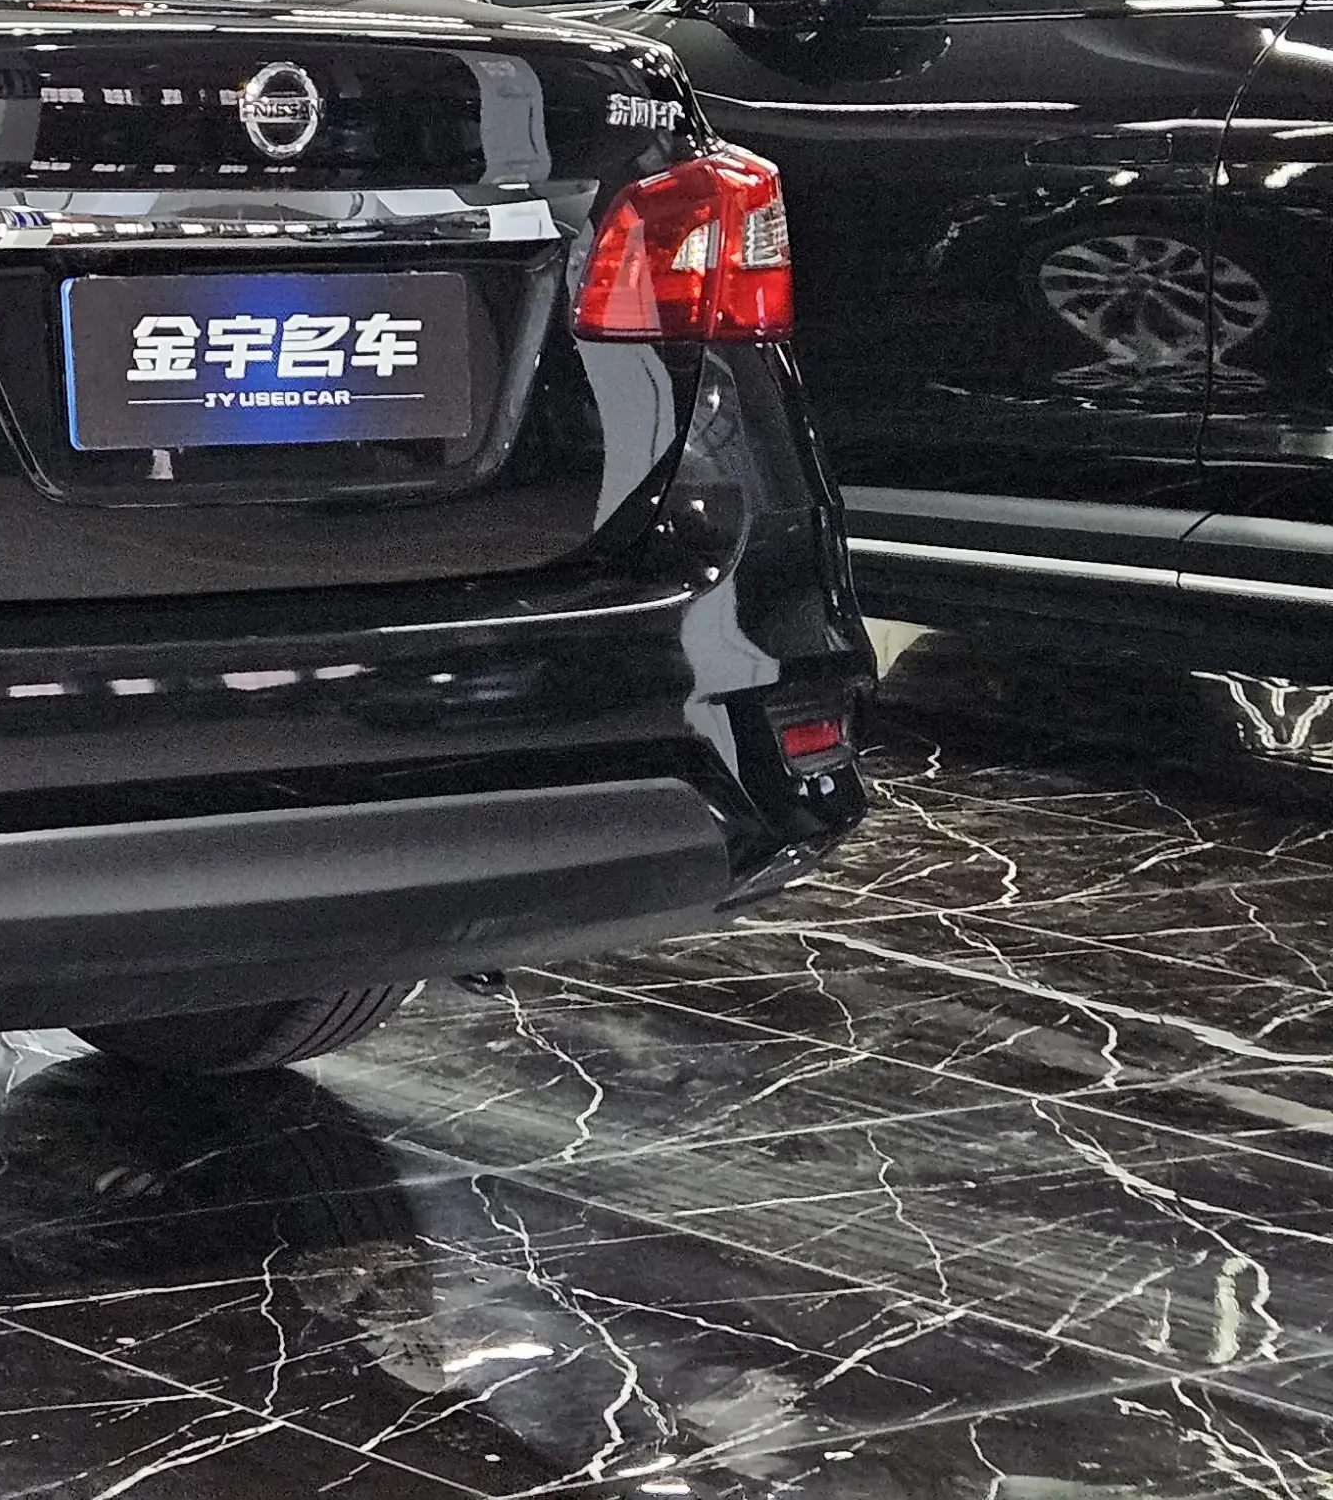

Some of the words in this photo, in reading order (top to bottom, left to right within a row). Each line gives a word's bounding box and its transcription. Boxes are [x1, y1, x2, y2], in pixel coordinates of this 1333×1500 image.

[126, 313, 423, 381] 金宇名车
[239, 391, 301, 407] USED
[302, 389, 351, 406] CAR
